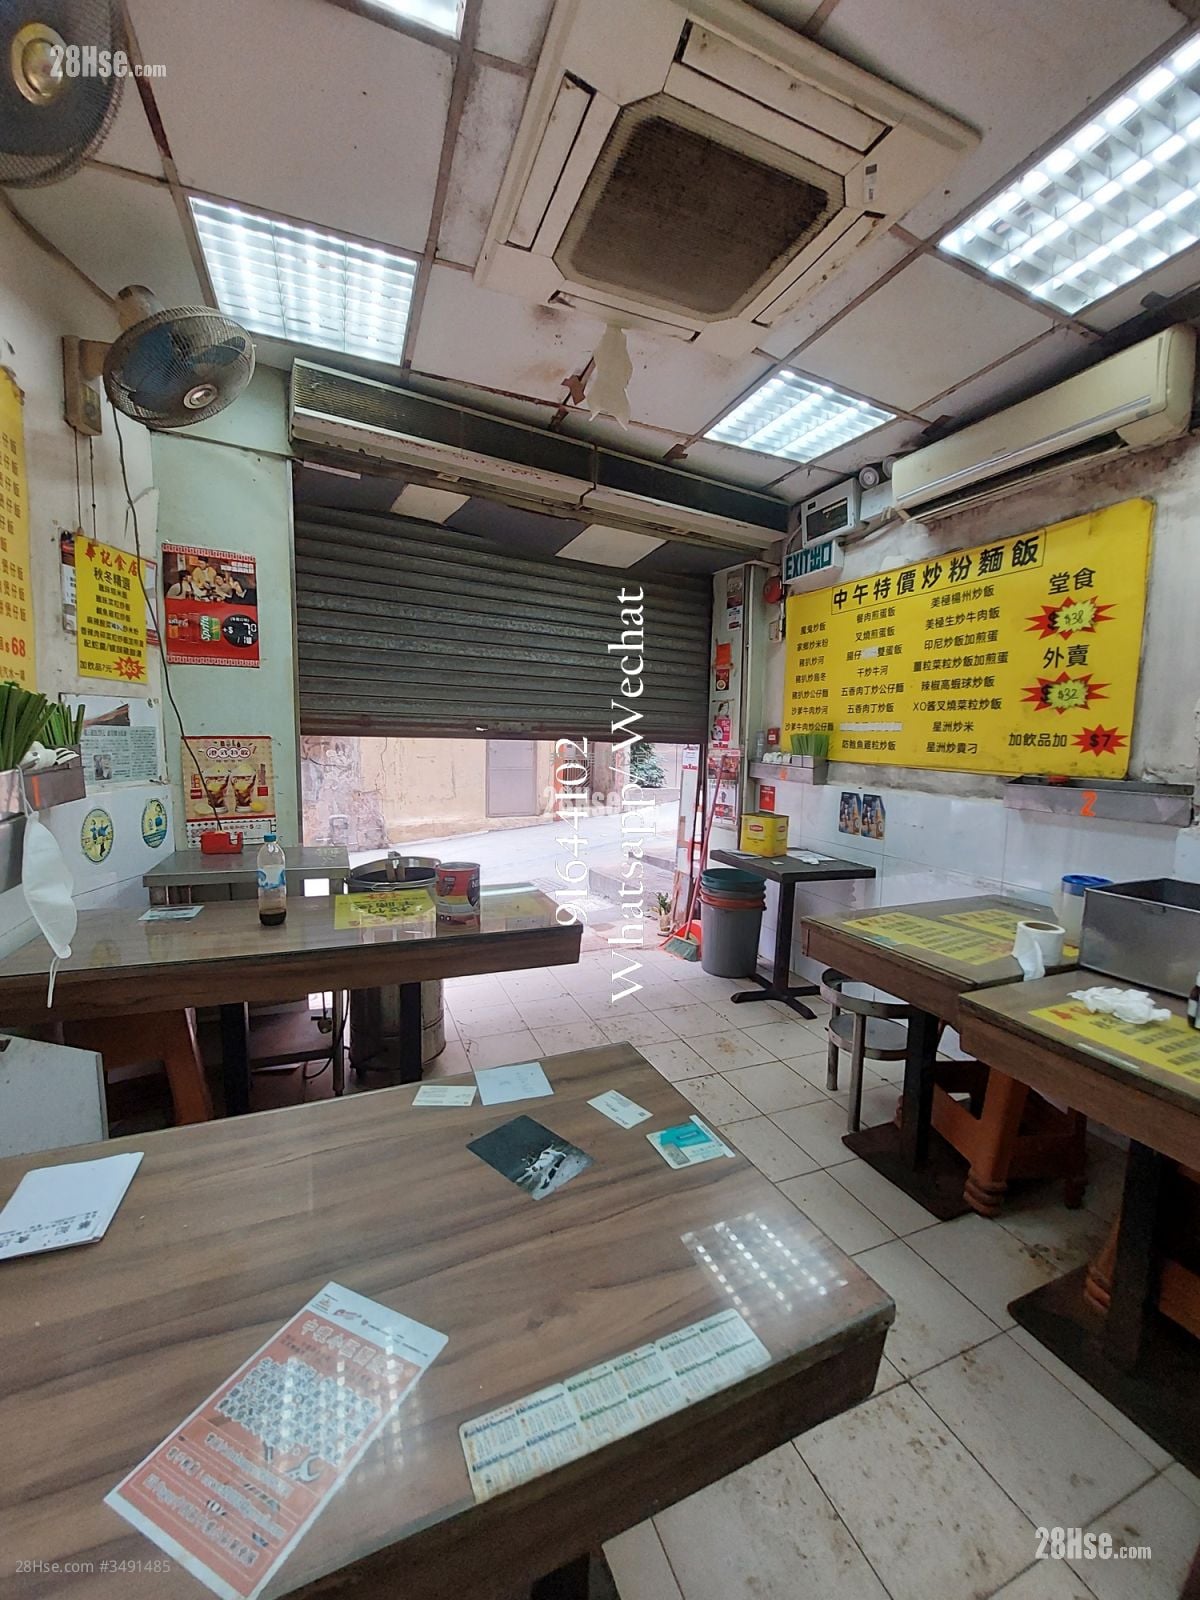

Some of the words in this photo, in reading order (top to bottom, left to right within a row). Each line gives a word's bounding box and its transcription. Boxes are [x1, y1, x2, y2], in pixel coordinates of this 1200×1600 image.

[785, 548, 810, 581] EXIT
[1047, 567, 1096, 595] 堂食
[924, 629, 998, 651] 印尼炒飯加煎蛋
[1043, 644, 1090, 669] 外賣
[932, 720, 974, 733] 星洲炒米
[1008, 732, 1068, 748] 加飲品加
[1089, 733, 1113, 748] $7
